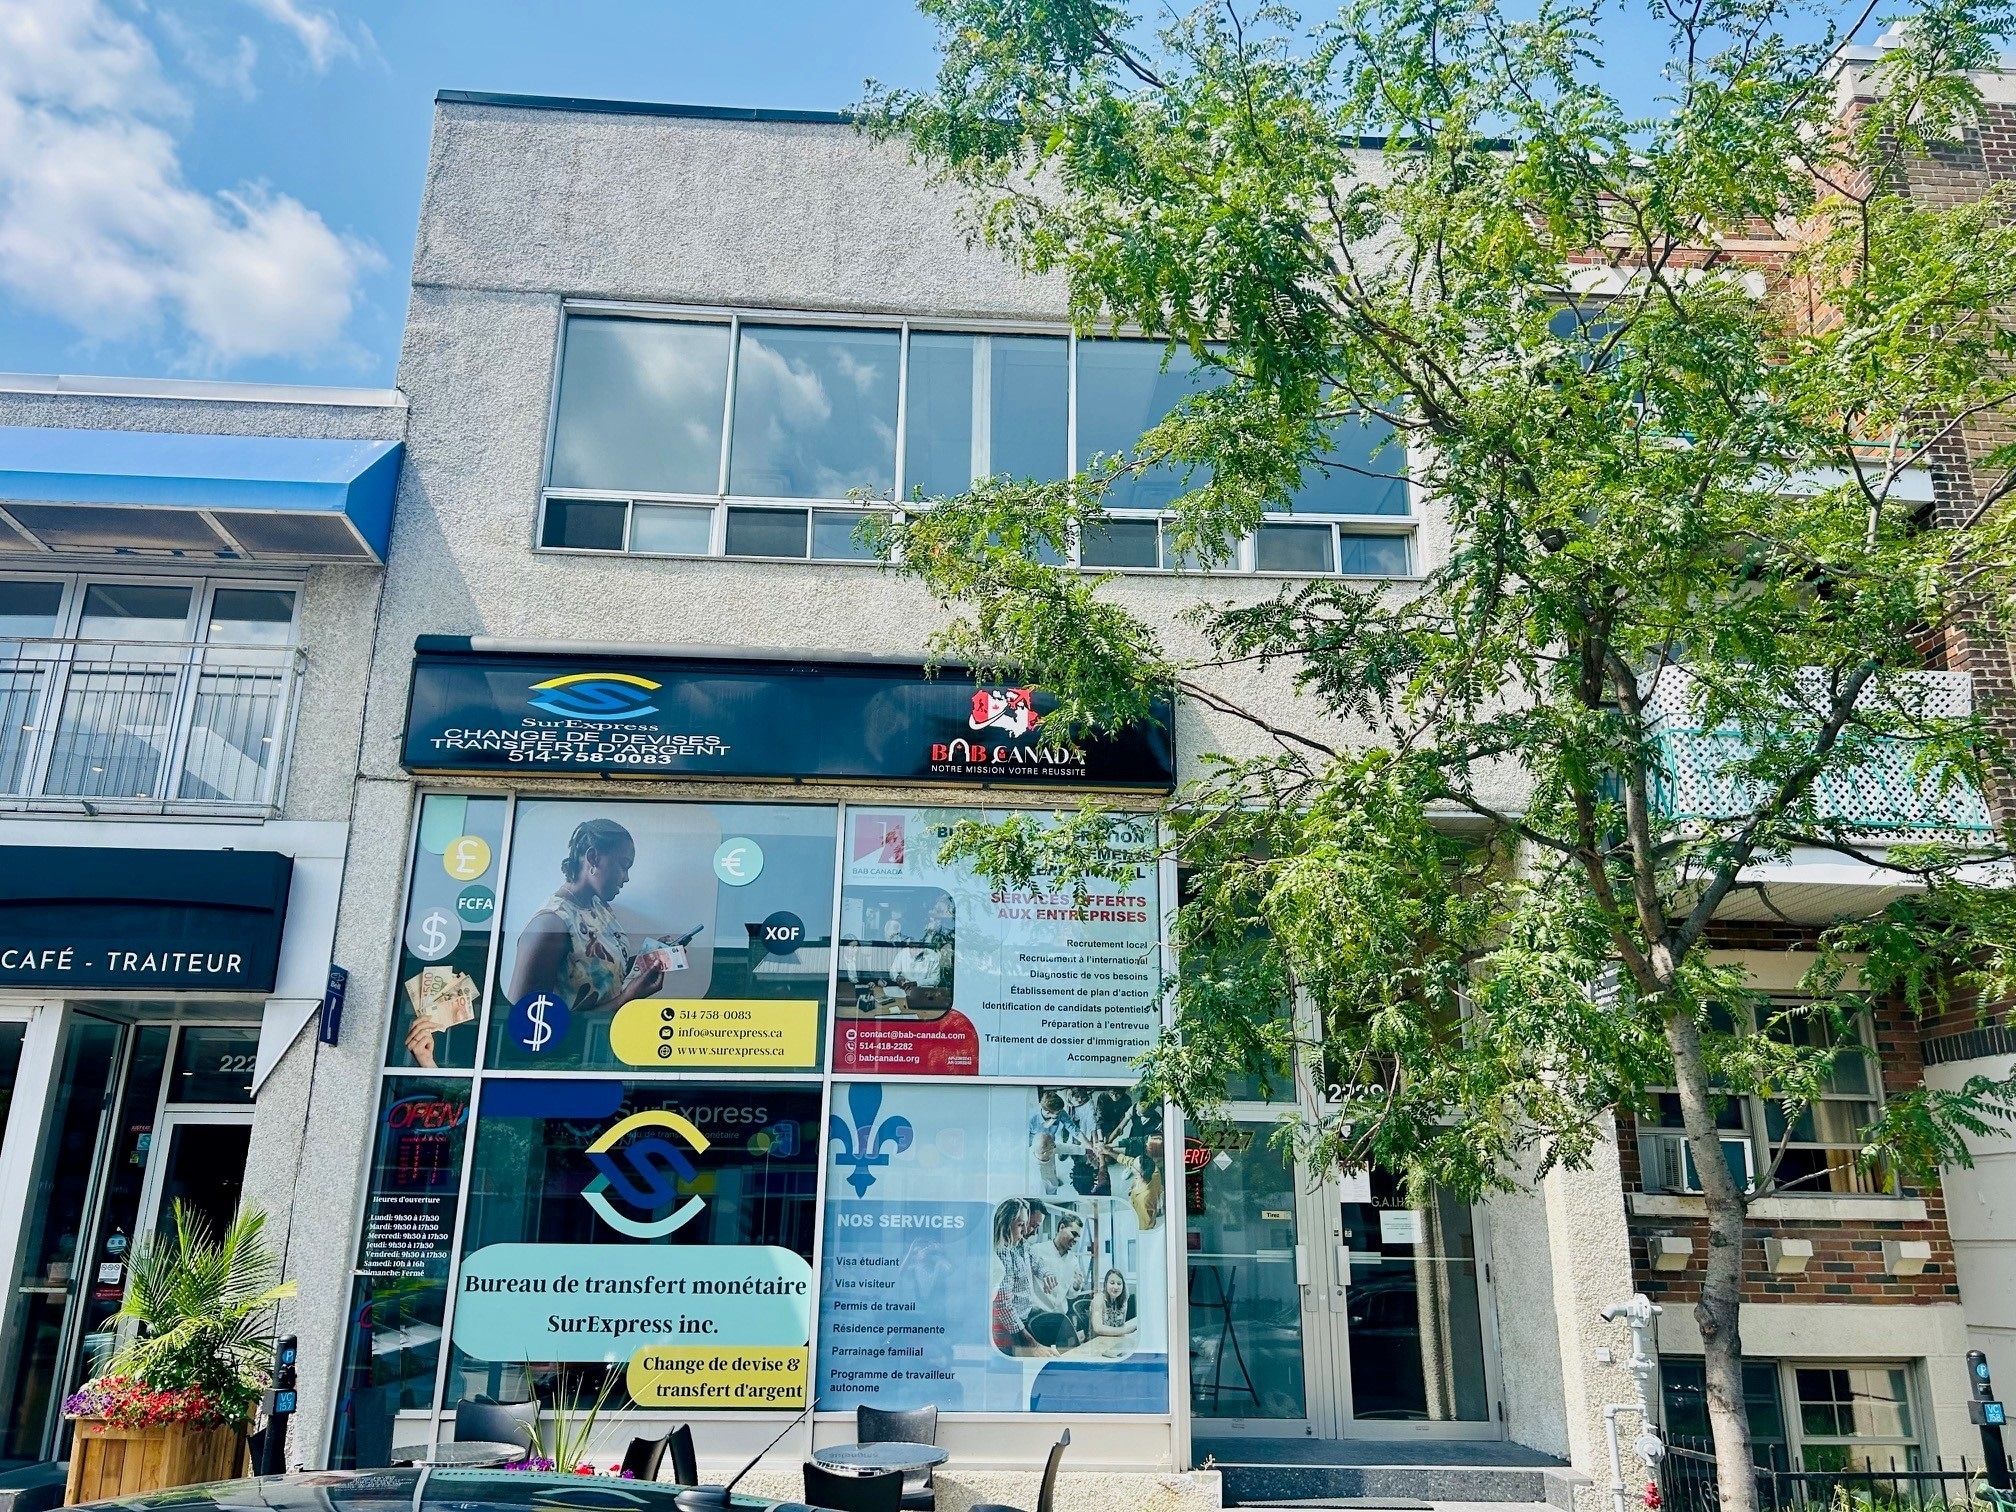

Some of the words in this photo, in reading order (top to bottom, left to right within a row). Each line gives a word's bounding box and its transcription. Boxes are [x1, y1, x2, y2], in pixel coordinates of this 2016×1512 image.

[521, 718, 659, 732] SurExpress
[444, 728, 557, 742] CHANGE
[567, 731, 599, 743] DE
[611, 733, 720, 745] DEVISES
[430, 738, 590, 752] TRANSFERT
[598, 742, 731, 756] D'ARGENT
[508, 750, 671, 764] 514-758-0083
[990, 745, 1086, 765] CANADA
[931, 764, 962, 773] NOTRE
[966, 765, 1005, 774] MISSION
[1008, 766, 1039, 775] VOTRE
[852, 867, 869, 875] BAB
[458, 897, 493, 911] FCFA
[991, 892, 1070, 905] SERVICES
[1080, 894, 1147, 907] FFERTS
[998, 908, 1031, 920] AUX
[1036, 909, 1147, 922] ENTREPRISES
[765, 926, 800, 940] XOF
[1066, 939, 1124, 949] Recrutement
[1126, 940, 1148, 949] local
[1, 946, 75, 971] CAFÉ
[107, 952, 242, 974] TRAITEUR
[1019, 953, 1076, 963] Recrutement
[1079, 955, 1084, 963] à
[1086, 955, 1148, 965] l'international
[1030, 970, 1078, 981] Diagnostic
[1080, 971, 1091, 980] de
[1112, 971, 1148, 981] besoins
[1010, 984, 1075, 996] Établissement
[1077, 987, 1088, 996] de
[1090, 987, 1110, 998] plan
[1112, 988, 1149, 998] d'action
[982, 1001, 1041, 1011] Identification
[1044, 1003, 1055, 1012] de
[1057, 1003, 1102, 1013] candidats
[1104, 1005, 1150, 1014] potentiels
[679, 1010, 697, 1020] 514
[700, 1010, 752, 1020] 758-0083
[1041, 1019, 1094, 1030] Préparation
[1096, 1020, 1102, 1029] à
[1104, 1020, 1150, 1030] l'entrevue
[678, 1027, 783, 1039] info@surexpress.ca
[860, 1030, 966, 1040] contact@bab-canada.com
[859, 1042, 913, 1050] 514-418-2282
[985, 1033, 1035, 1044] Traitement
[1036, 1035, 1048, 1044] de
[1050, 1036, 1084, 1045] dossier
[1086, 1036, 1150, 1048] d'immigration
[677, 1047, 785, 1058] www.surexpress.ca
[858, 1054, 920, 1064] babcanada.org
[389, 1102, 464, 1128] OPEN
[398, 1196, 441, 1204] d'ouverture
[419, 1214, 440, 1222] 17h30
[837, 1213, 874, 1227] NOS
[879, 1214, 965, 1229] SERVICES
[367, 1232, 402, 1240] Mercredi:
[365, 1242, 388, 1250] Jeudi:
[412, 1260, 425, 1268] 16h
[836, 1256, 857, 1266] Visa
[859, 1256, 900, 1266] étudiant
[401, 1269, 425, 1277] Fermé
[464, 1275, 547, 1293] Bureau
[552, 1274, 579, 1294] de
[584, 1274, 686, 1295] transfert
[692, 1276, 807, 1296] monétaire
[835, 1278, 856, 1288] Visa
[858, 1279, 896, 1288] visiteur
[833, 1301, 868, 1311] Permis
[871, 1302, 883, 1311] de
[885, 1302, 916, 1311] travail
[547, 1315, 673, 1338] SurExpress
[679, 1315, 719, 1335] inc.
[832, 1323, 884, 1334] Résidence
[886, 1325, 945, 1335] permanente
[831, 1346, 886, 1358] Parrainage
[887, 1346, 924, 1357] familial
[643, 1356, 706, 1374] Change
[708, 1356, 728, 1371] de
[731, 1357, 784, 1372] devise
[786, 1358, 801, 1372] &
[830, 1369, 888, 1381] Programme
[891, 1370, 903, 1379] de
[905, 1370, 956, 1380] travailleur
[656, 1382, 730, 1398] transfert
[734, 1383, 803, 1401] d'argent
[830, 1384, 880, 1392] autonome
[281, 1392, 293, 1402] VC
[279, 1402, 292, 1411] 157
[1987, 1404, 2000, 1413] VC
